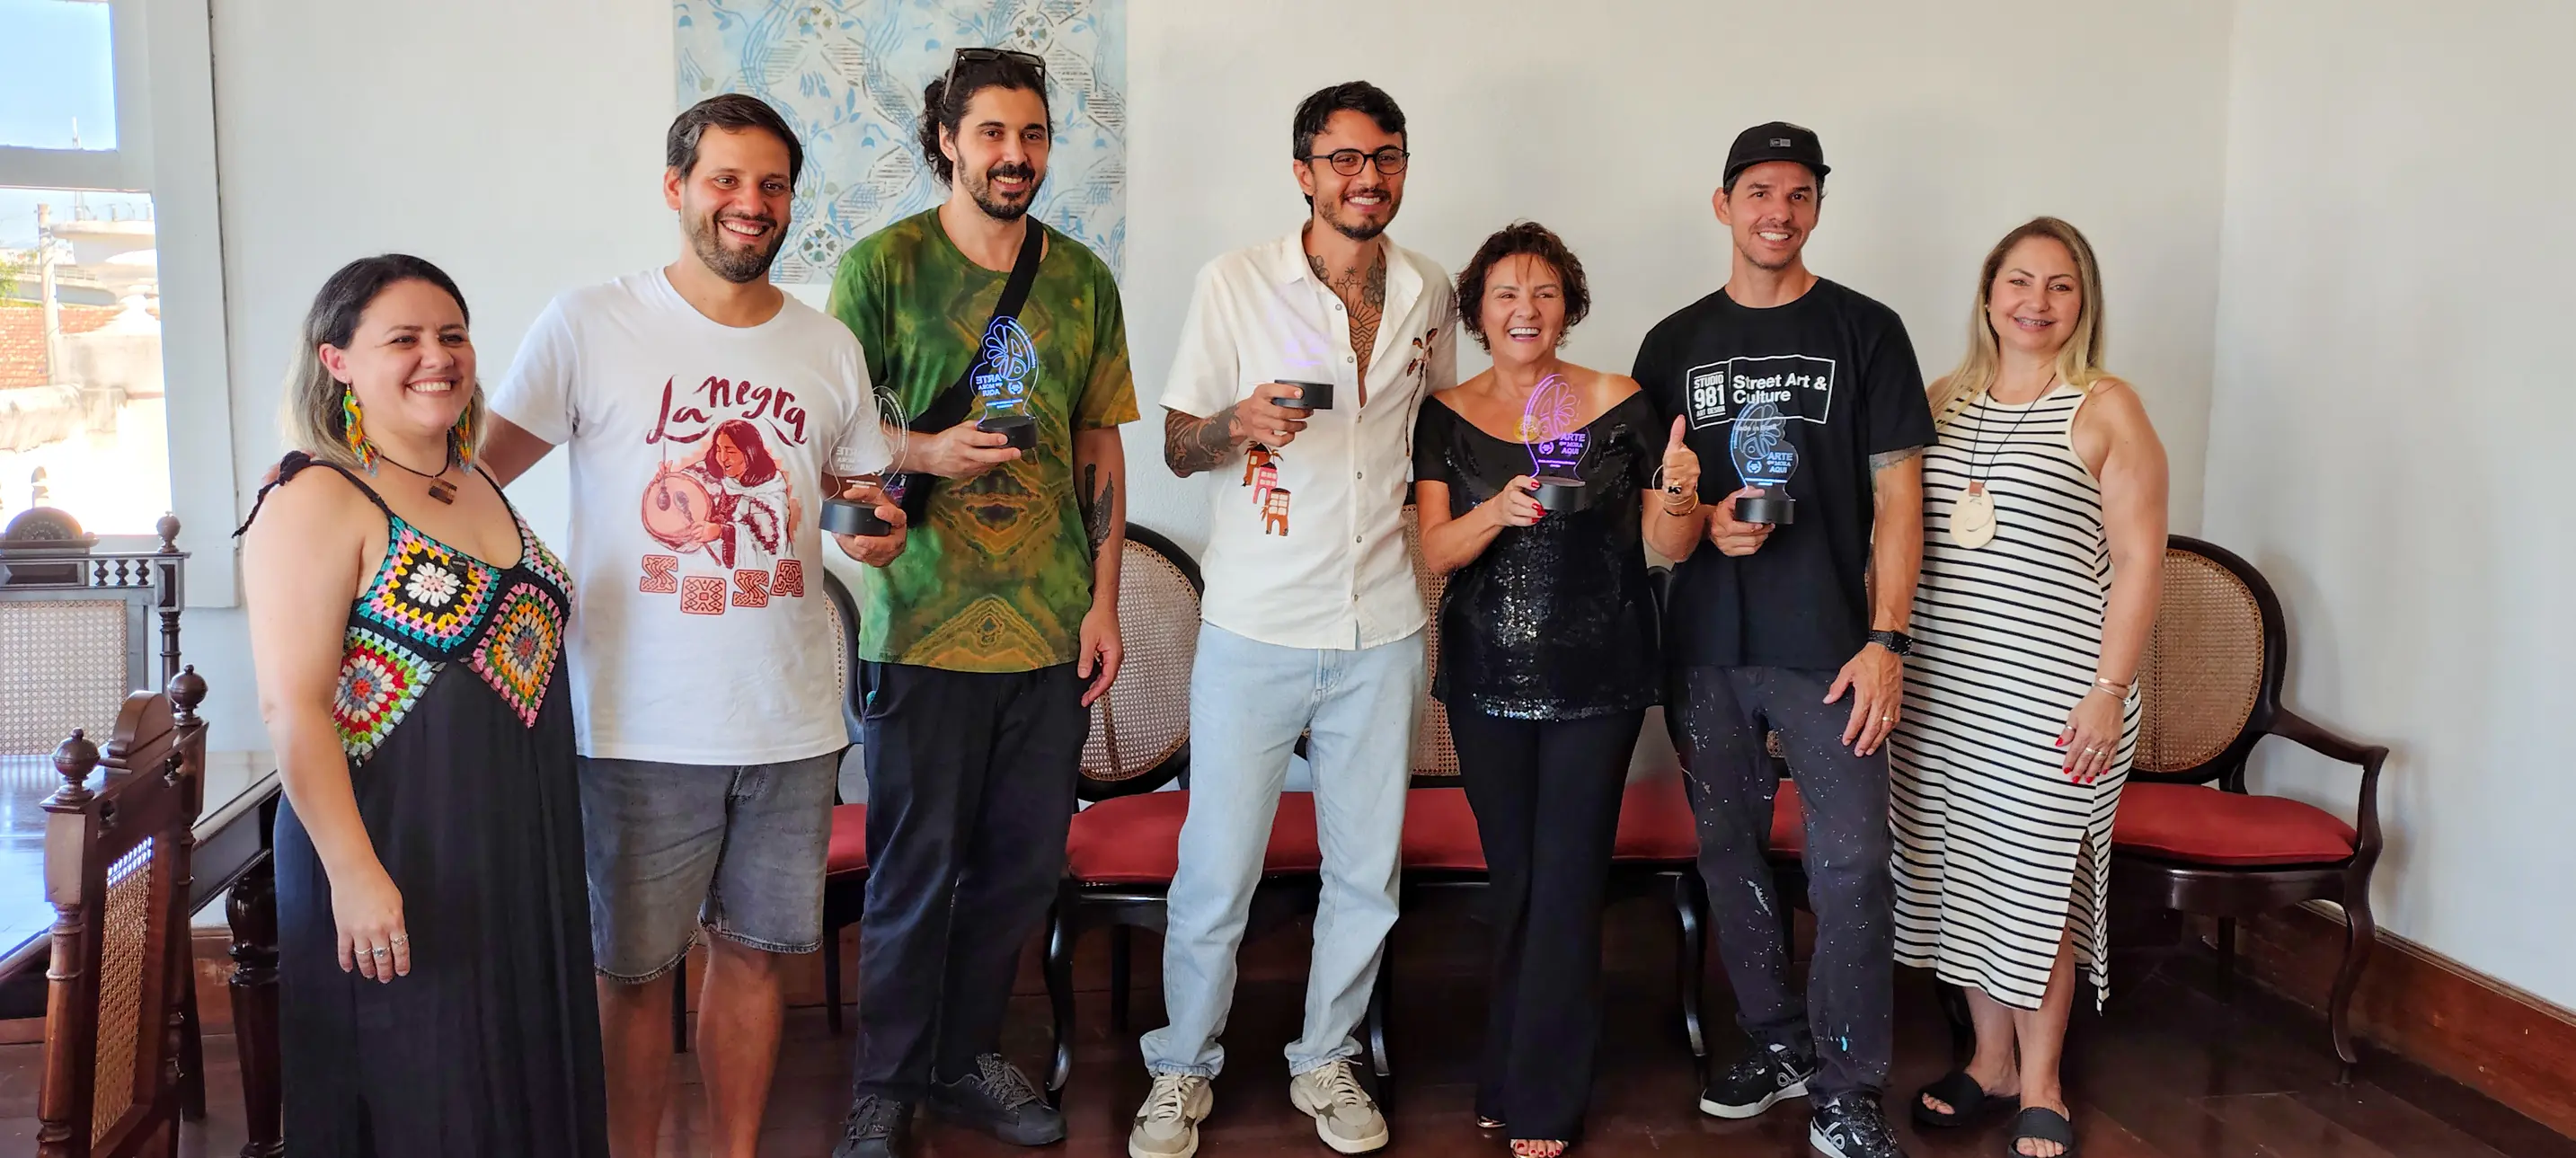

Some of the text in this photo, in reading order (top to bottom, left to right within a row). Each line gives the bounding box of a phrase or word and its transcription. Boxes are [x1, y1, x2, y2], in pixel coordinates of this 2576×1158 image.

[1694, 375, 1724, 389] STUDIO
[1733, 373, 1827, 390] Street Art &
[1694, 385, 1724, 409] 981
[1733, 390, 1791, 403] Culture
[646, 374, 715, 445] La
[693, 376, 808, 448] negra
[1560, 433, 1585, 441] ARTE
[1767, 452, 1793, 460] ARTE
